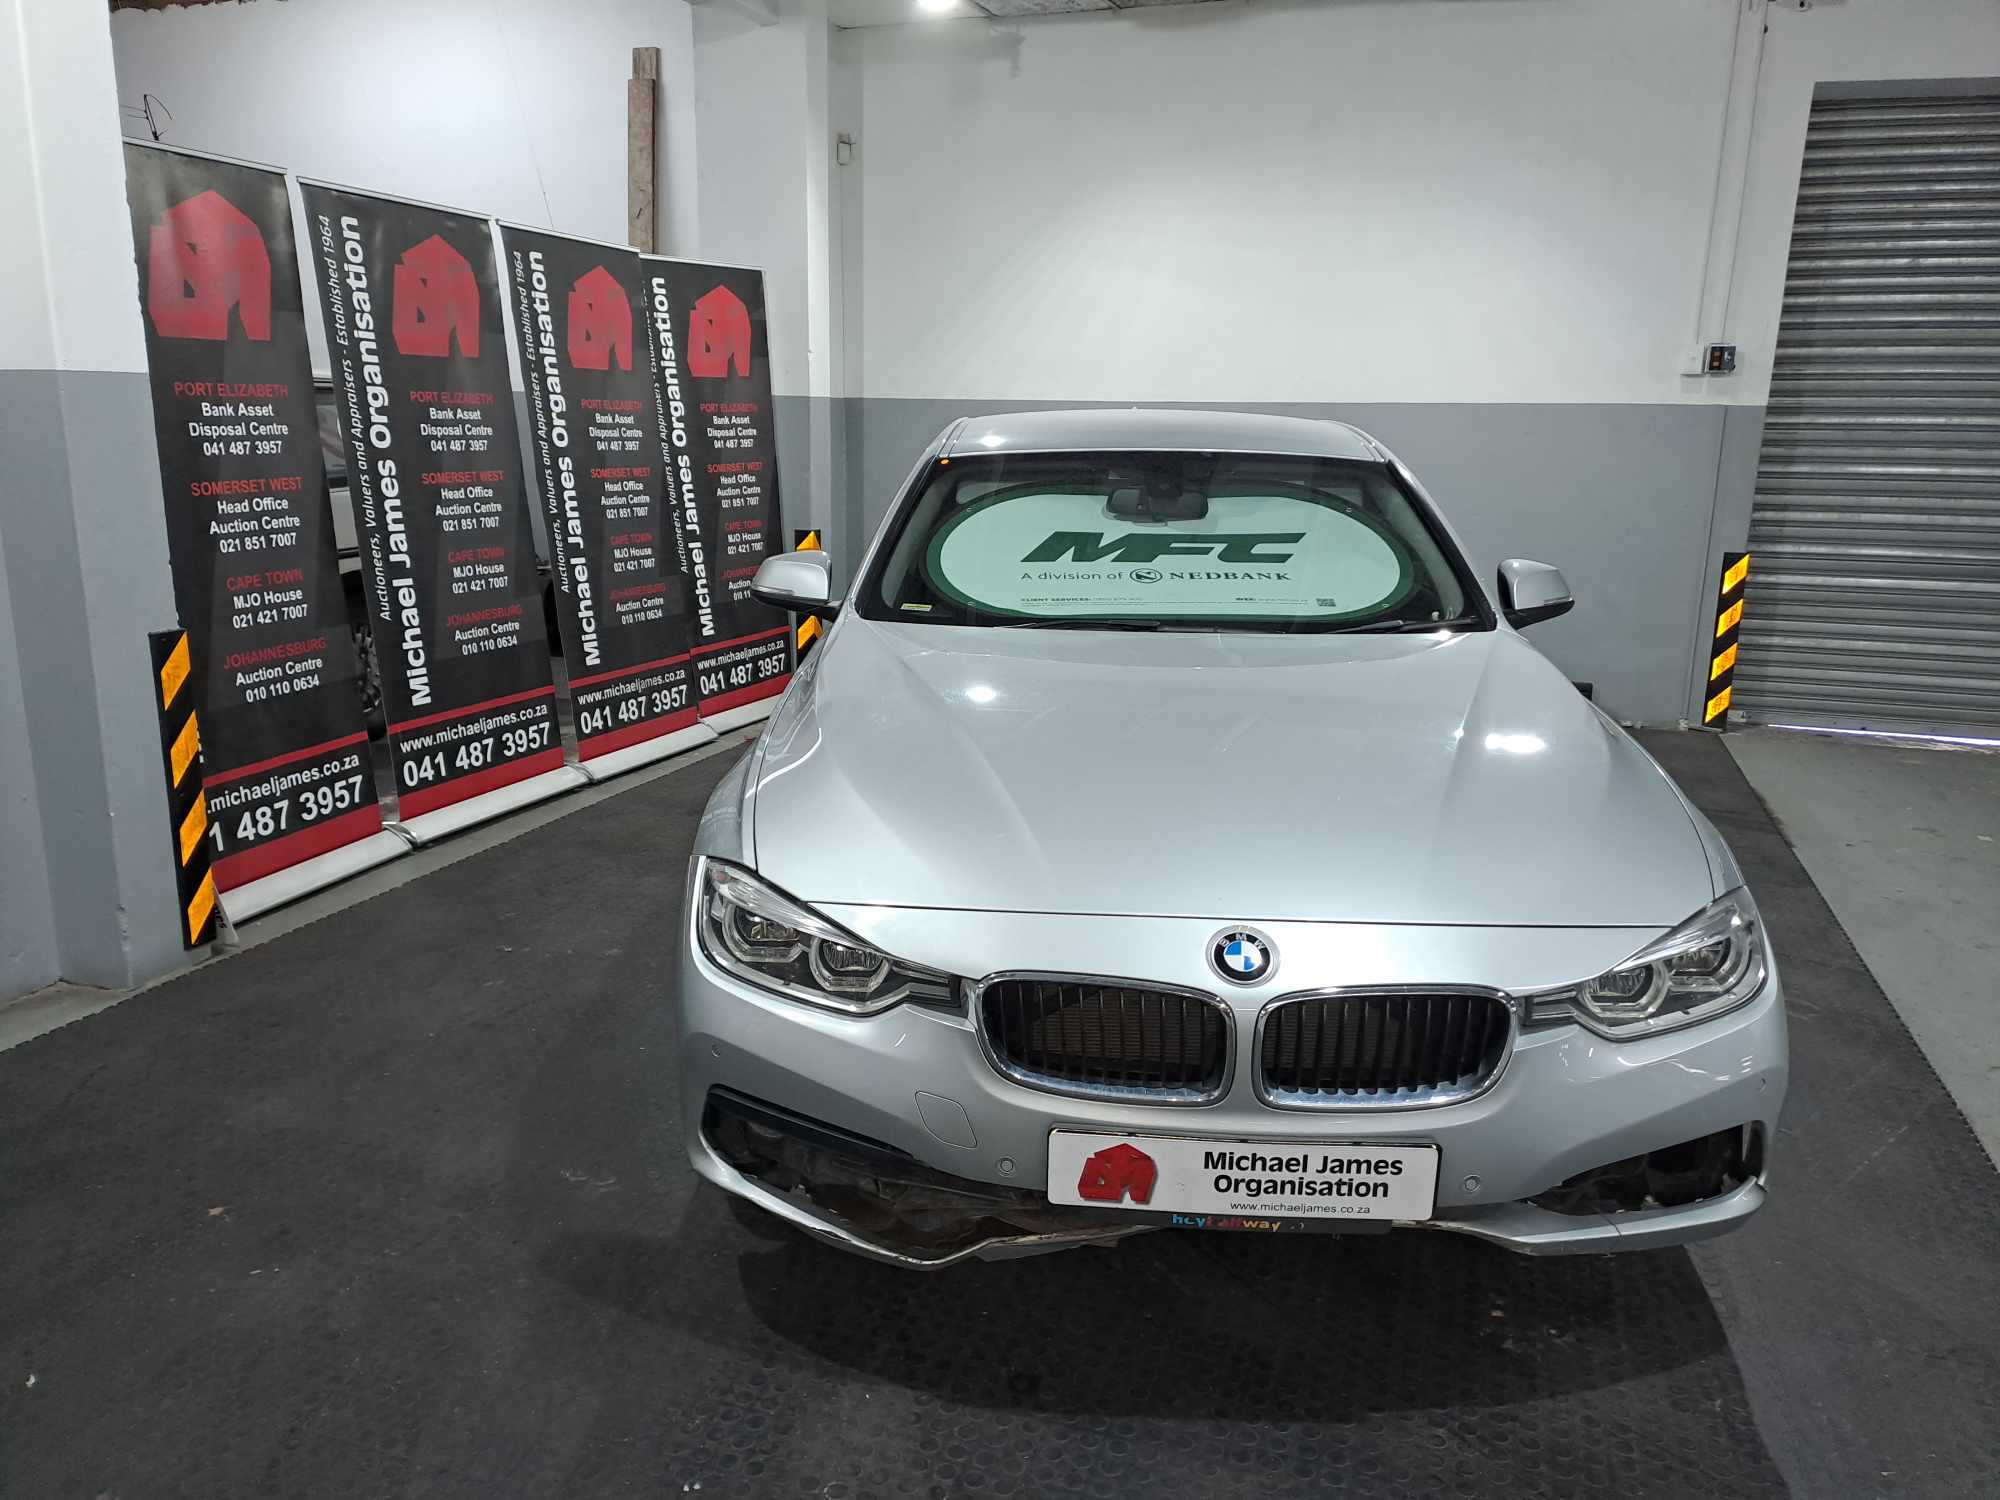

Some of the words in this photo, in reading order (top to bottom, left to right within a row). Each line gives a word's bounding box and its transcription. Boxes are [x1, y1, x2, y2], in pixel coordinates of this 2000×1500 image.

[318, 214, 335, 253] 1964
[324, 257, 349, 346] Established
[340, 215, 391, 449] organisation
[518, 286, 535, 361] Established
[528, 250, 569, 448] organisation
[651, 277, 687, 448] organisation
[174, 382, 213, 396] PORT
[218, 384, 288, 397] ELIZABETH
[342, 359, 365, 438] Appraisers
[410, 391, 438, 402] PORT
[201, 402, 235, 417] Bank
[238, 403, 274, 417] Asset
[429, 407, 455, 420] Bank
[456, 408, 482, 420] Asset
[530, 371, 548, 439] Appraisers
[188, 422, 246, 439] Disposal
[250, 421, 288, 436] Centre
[420, 423, 462, 438] Disposal
[464, 424, 493, 436] Centre
[595, 413, 613, 423] Bank
[589, 427, 619, 439] Disposal
[621, 427, 643, 437] Centre
[203, 442, 225, 456] 041
[229, 441, 250, 455] 487
[255, 441, 282, 454] 3957
[351, 440, 368, 470] and
[430, 440, 447, 452] 041
[449, 440, 466, 452] 487
[470, 440, 487, 451] 3957
[538, 440, 551, 465] and
[191, 479, 265, 496] SOMERSET
[270, 477, 303, 491] WEST
[421, 472, 476, 484] SOMERSET
[479, 470, 504, 481] WEST
[604, 482, 621, 492] Head
[623, 481, 644, 490] Office
[360, 474, 377, 528] Valuers
[441, 488, 464, 500] Head
[467, 486, 493, 498] Office
[545, 469, 558, 514] Valuers
[558, 456, 584, 550] James
[601, 495, 627, 506] Auction
[677, 454, 700, 535] James
[217, 500, 249, 514] Head
[252, 497, 288, 511] Office
[377, 459, 411, 569] James
[435, 503, 472, 516] Auction
[473, 502, 502, 513] Centre
[209, 518, 259, 535] Auction
[261, 515, 300, 530] Centre
[443, 520, 459, 531] 021
[461, 518, 477, 530] 851
[480, 516, 499, 528] 7007
[219, 539, 241, 553] 021
[244, 537, 266, 550] 851
[270, 532, 297, 547] 7007
[1020, 531, 1306, 563] MFC
[552, 519, 570, 593] Auctioneers,
[226, 574, 262, 591] CAPE
[266, 569, 303, 585] TOWN
[369, 533, 393, 621] Auctioneers,
[453, 565, 473, 578] MJO
[475, 563, 504, 576] House
[1020, 572, 1033, 580] A
[1038, 571, 1101, 580] division
[1107, 571, 1123, 580] of
[1169, 572, 1292, 580] NEDBANK
[452, 582, 468, 594] 021
[470, 579, 486, 591] 421
[488, 576, 508, 588] 7007
[687, 541, 716, 637] Michael
[233, 592, 261, 610] MJO
[264, 589, 303, 605] House
[570, 556, 601, 667] Michael
[616, 600, 641, 612] Auction
[232, 613, 253, 629] 021
[257, 609, 278, 625] 421
[281, 604, 308, 620] 7007
[391, 577, 432, 707] Michael
[454, 626, 489, 641] Auction
[491, 621, 520, 635] Centre
[224, 637, 326, 669] JOHANNESBURG
[462, 643, 478, 655] 010
[480, 639, 495, 652] 110
[496, 635, 518, 648] 0634
[235, 667, 283, 687] Auction
[285, 657, 323, 675] Centre
[700, 670, 726, 695] 041
[730, 663, 752, 686] 487
[758, 653, 786, 678] 3957
[246, 686, 267, 702] 010
[269, 681, 290, 697] 110
[293, 674, 320, 691] 0634
[577, 668, 685, 705] www.michaeljames.co.za
[580, 705, 612, 734] 041
[618, 696, 647, 723] 487
[651, 684, 688, 713] 3957
[400, 704, 548, 753] www.michaeljames.co.za
[403, 751, 447, 787] 041
[455, 737, 494, 770] 487
[501, 721, 550, 757] 3957
[207, 754, 360, 814] .michaeljames.co.za
[236, 799, 290, 841] 487
[299, 774, 363, 821] 3957
[1218, 933, 1266, 950] BMW
[1204, 1151, 1308, 1173] Michael
[1316, 1155, 1403, 1176] James
[1213, 1174, 1389, 1198] Organisation
